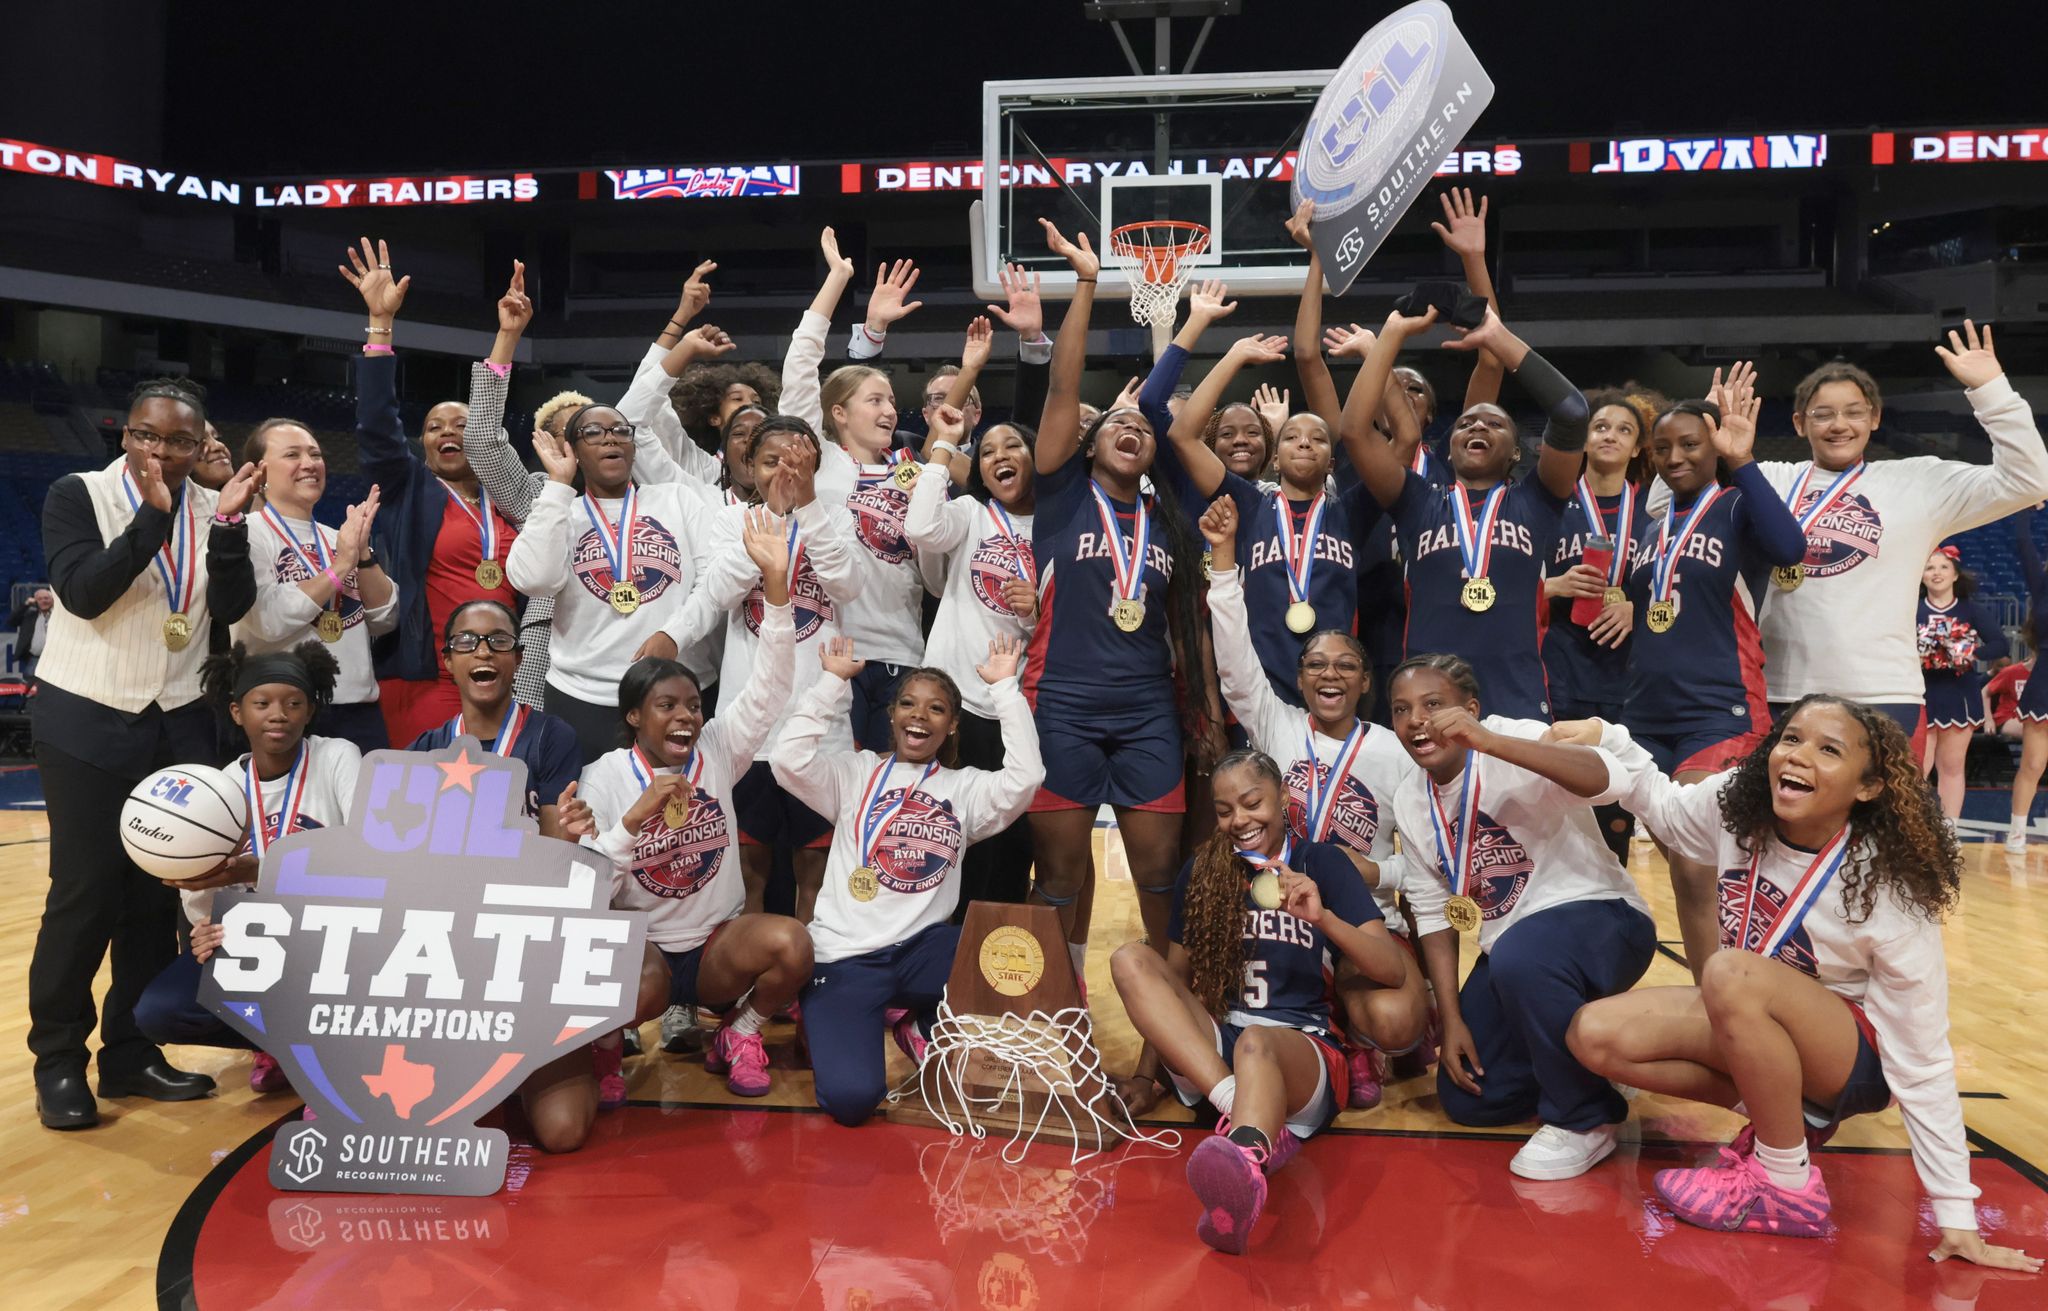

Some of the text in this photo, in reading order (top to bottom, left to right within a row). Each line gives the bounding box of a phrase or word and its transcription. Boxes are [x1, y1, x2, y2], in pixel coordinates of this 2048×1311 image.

[1320, 40, 1432, 167] UIL
[1367, 82, 1472, 222] SOUTHERN
[113, 163, 240, 205] RYAN
[878, 164, 1050, 189] DENTON
[255, 178, 538, 207] LADY RAIDERS
[1373, 160, 1428, 231] RECOGNITION
[1821, 552, 1863, 575] ENOUGH
[150, 776, 195, 808] UIL
[893, 790, 932, 804] 226
[362, 763, 525, 858] UIL
[128, 816, 175, 843] Baden
[670, 852, 701, 871] RYAN
[894, 850, 925, 860] RYAN
[639, 873, 662, 893] ONCE
[663, 889, 674, 897] IS
[676, 885, 695, 897] NOT
[880, 874, 891, 884] IS
[892, 882, 913, 891] NOT
[1501, 876, 1526, 912] ENOUGH
[212, 902, 631, 1007] STATE
[999, 972, 1024, 982] STATE
[308, 1004, 516, 1042] CHAMPIONS
[339, 1134, 492, 1167] SOUTHERN
[336, 1170, 446, 1183] RECOGNITION INC.
